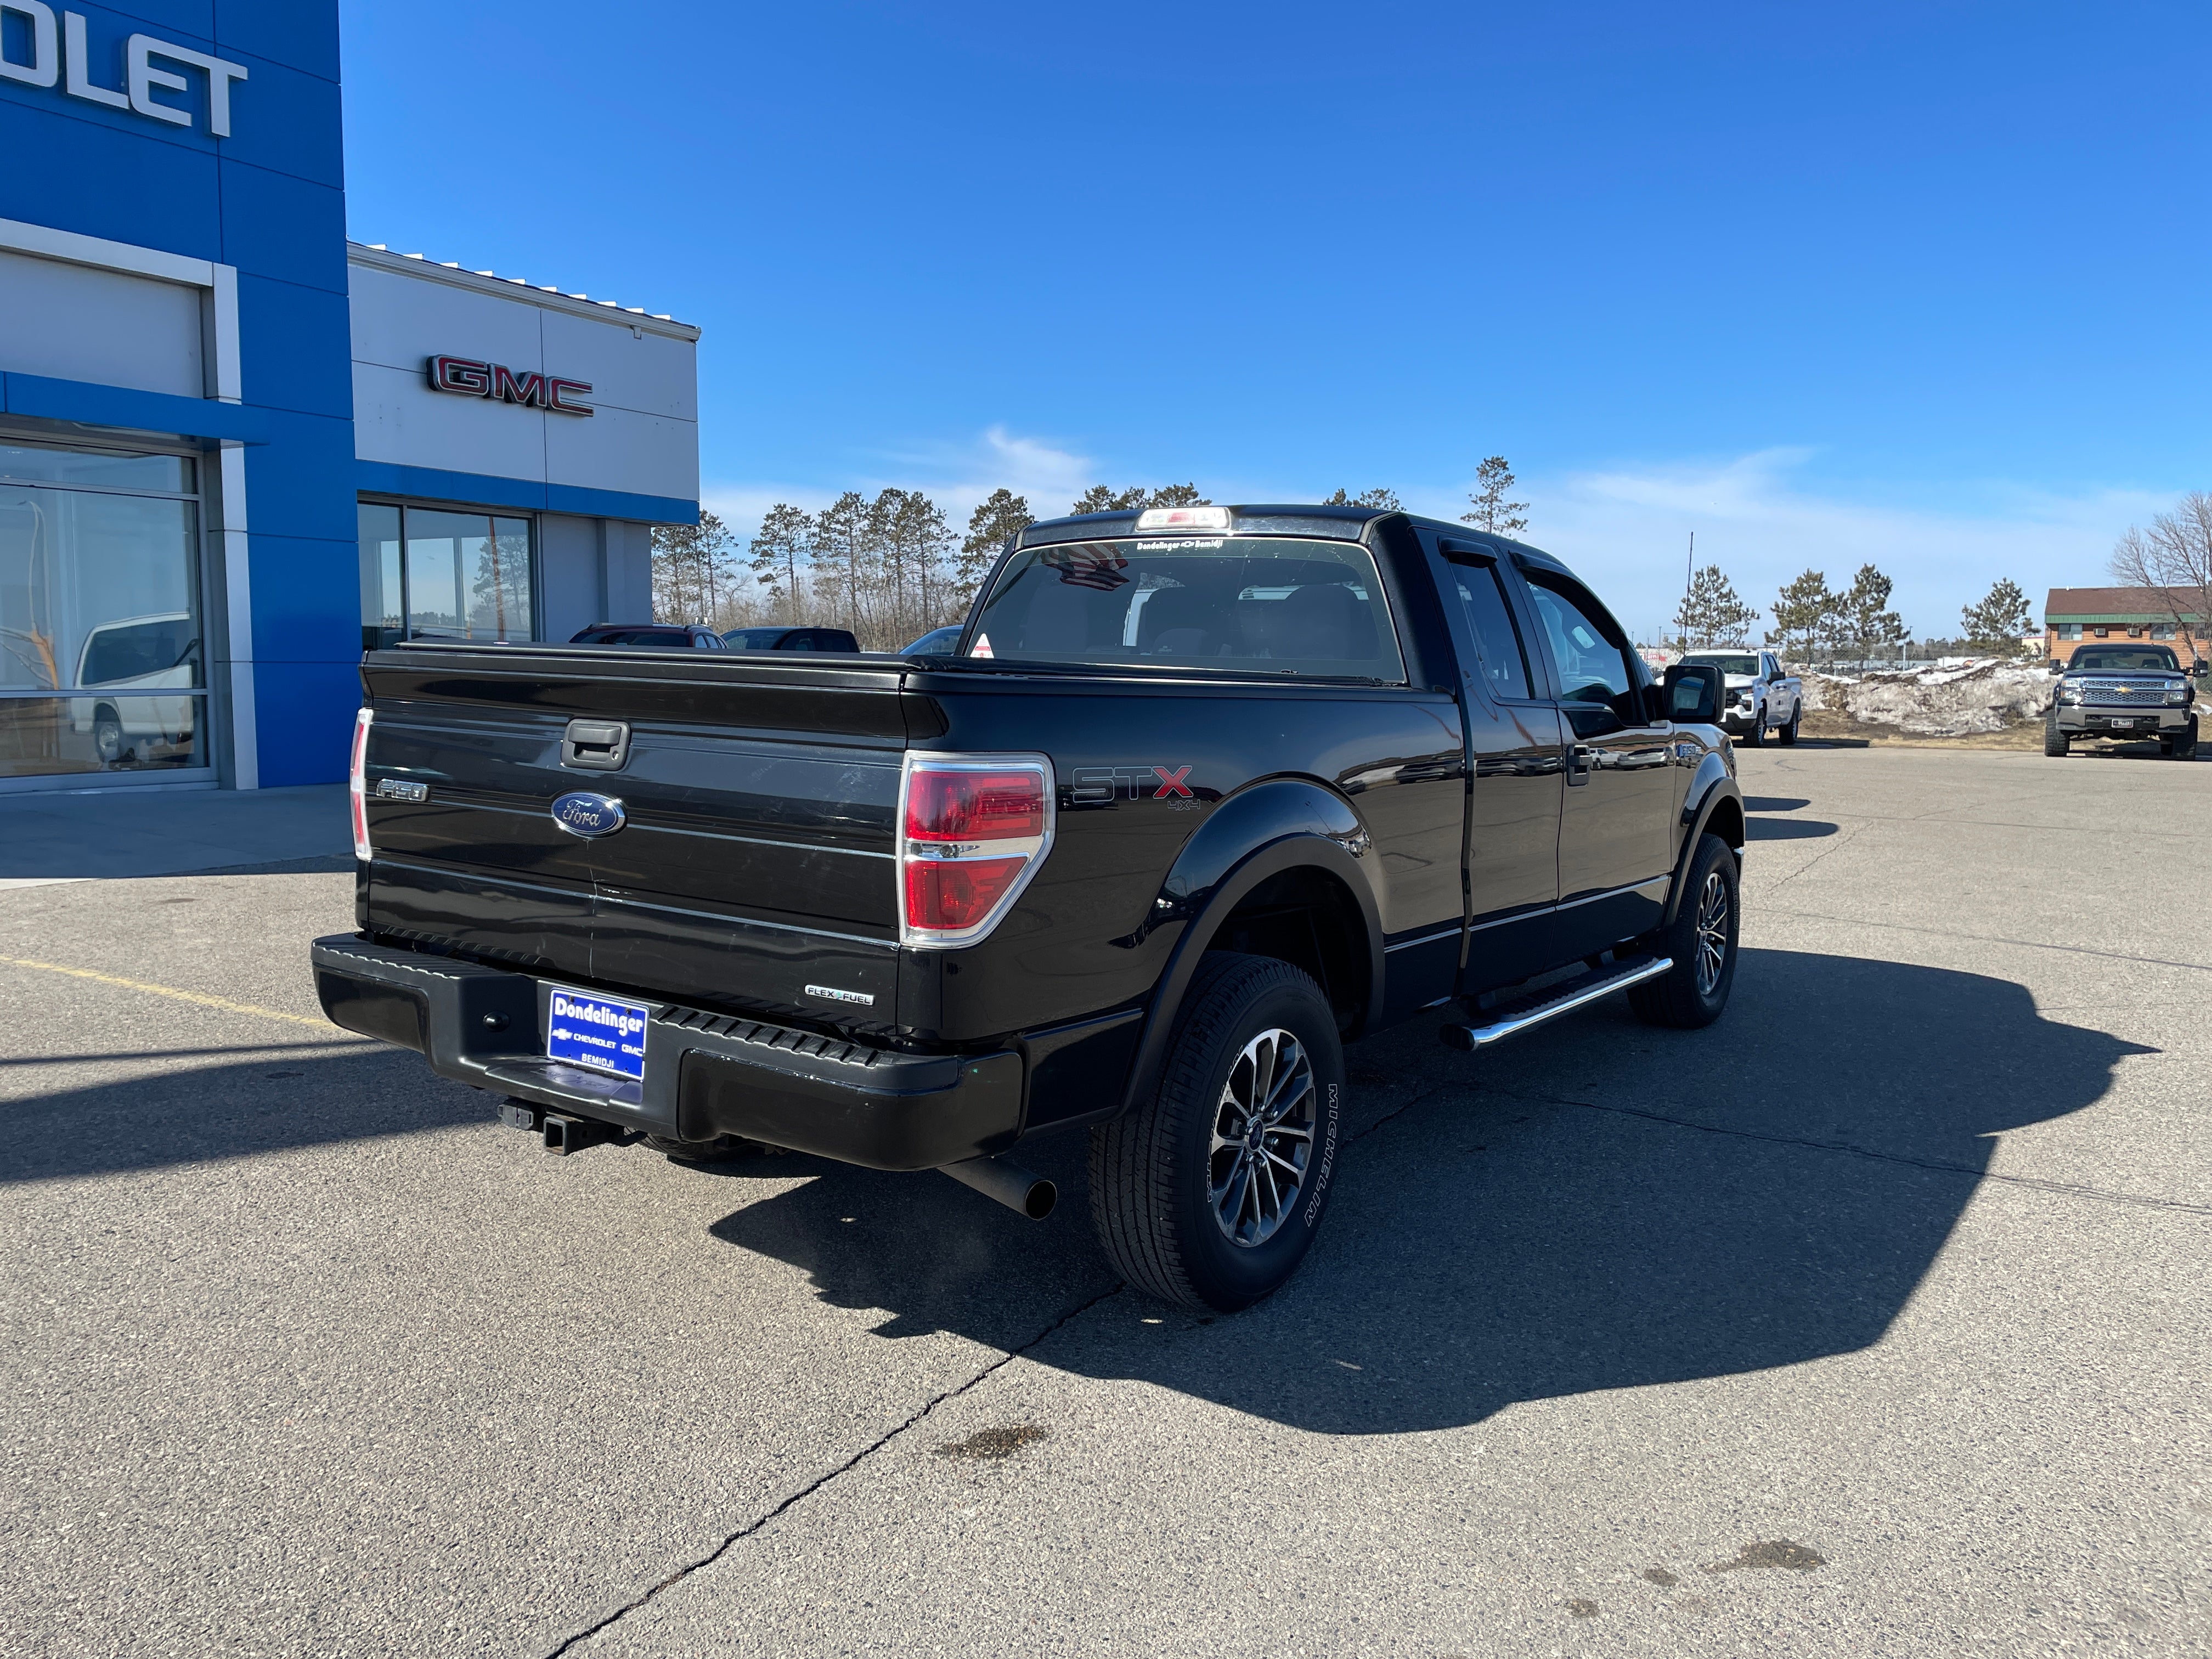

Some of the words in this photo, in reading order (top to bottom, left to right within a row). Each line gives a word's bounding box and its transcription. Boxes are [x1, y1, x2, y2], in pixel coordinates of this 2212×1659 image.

[427, 354, 594, 417] GMC
[1137, 541, 1180, 551] Dondelinger
[1194, 539, 1223, 549] Bemidji
[1073, 765, 1194, 803] STX
[562, 799, 602, 828] Ford
[808, 987, 834, 998] FLEX
[843, 993, 871, 1005] FUEL
[554, 996, 644, 1037] Dondelinger
[573, 1032, 617, 1049] CHEVROLET
[621, 1043, 644, 1057] GMC
[582, 1053, 614, 1069] BEMIDJI
[1304, 1084, 1338, 1227] MICHELIN
